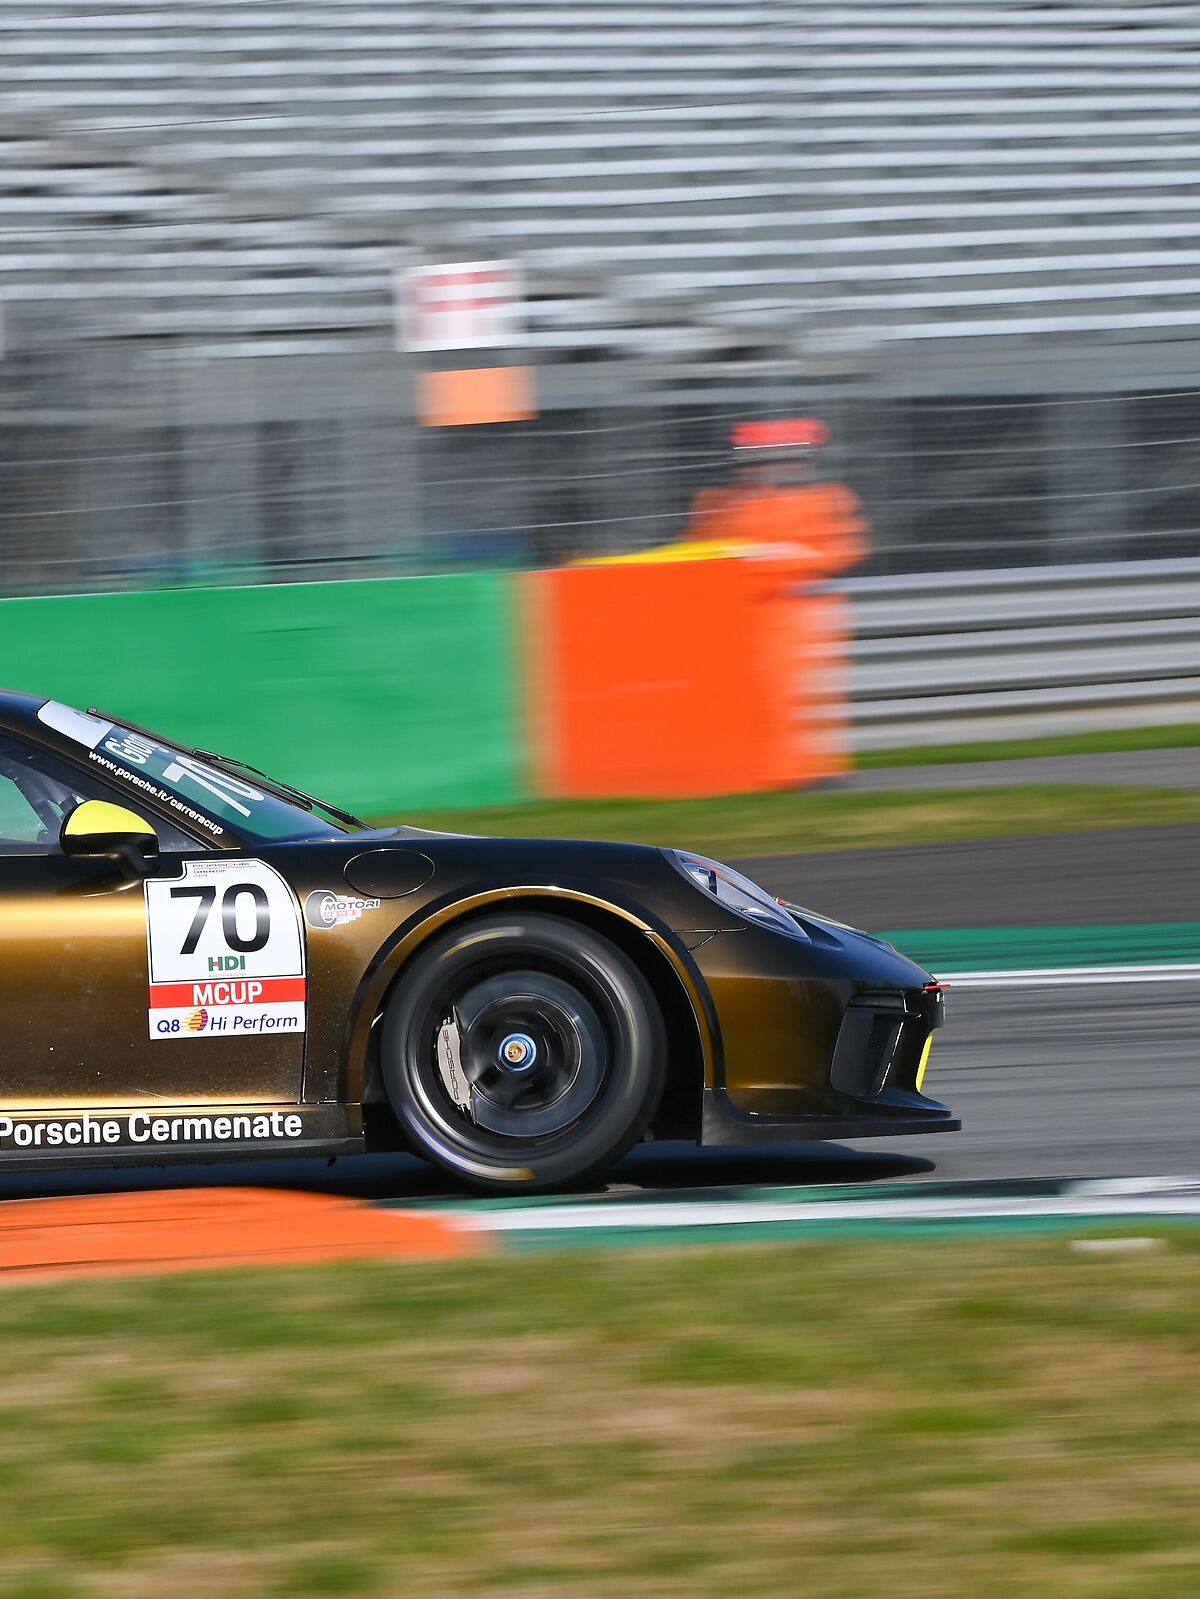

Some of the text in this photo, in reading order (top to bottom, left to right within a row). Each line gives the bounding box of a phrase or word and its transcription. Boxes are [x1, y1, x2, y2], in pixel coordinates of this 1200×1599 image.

[88, 750, 224, 836] www.porsche.it/carreracup
[169, 882, 271, 955] 70
[324, 900, 379, 911] MOTORI
[208, 955, 246, 971] HDI
[192, 981, 263, 1006] MCUP
[156, 1014, 298, 1034] Q8 Hi Perform
[442, 1029, 460, 1101] PORSCHE
[128, 1111, 303, 1143] Cermenate
